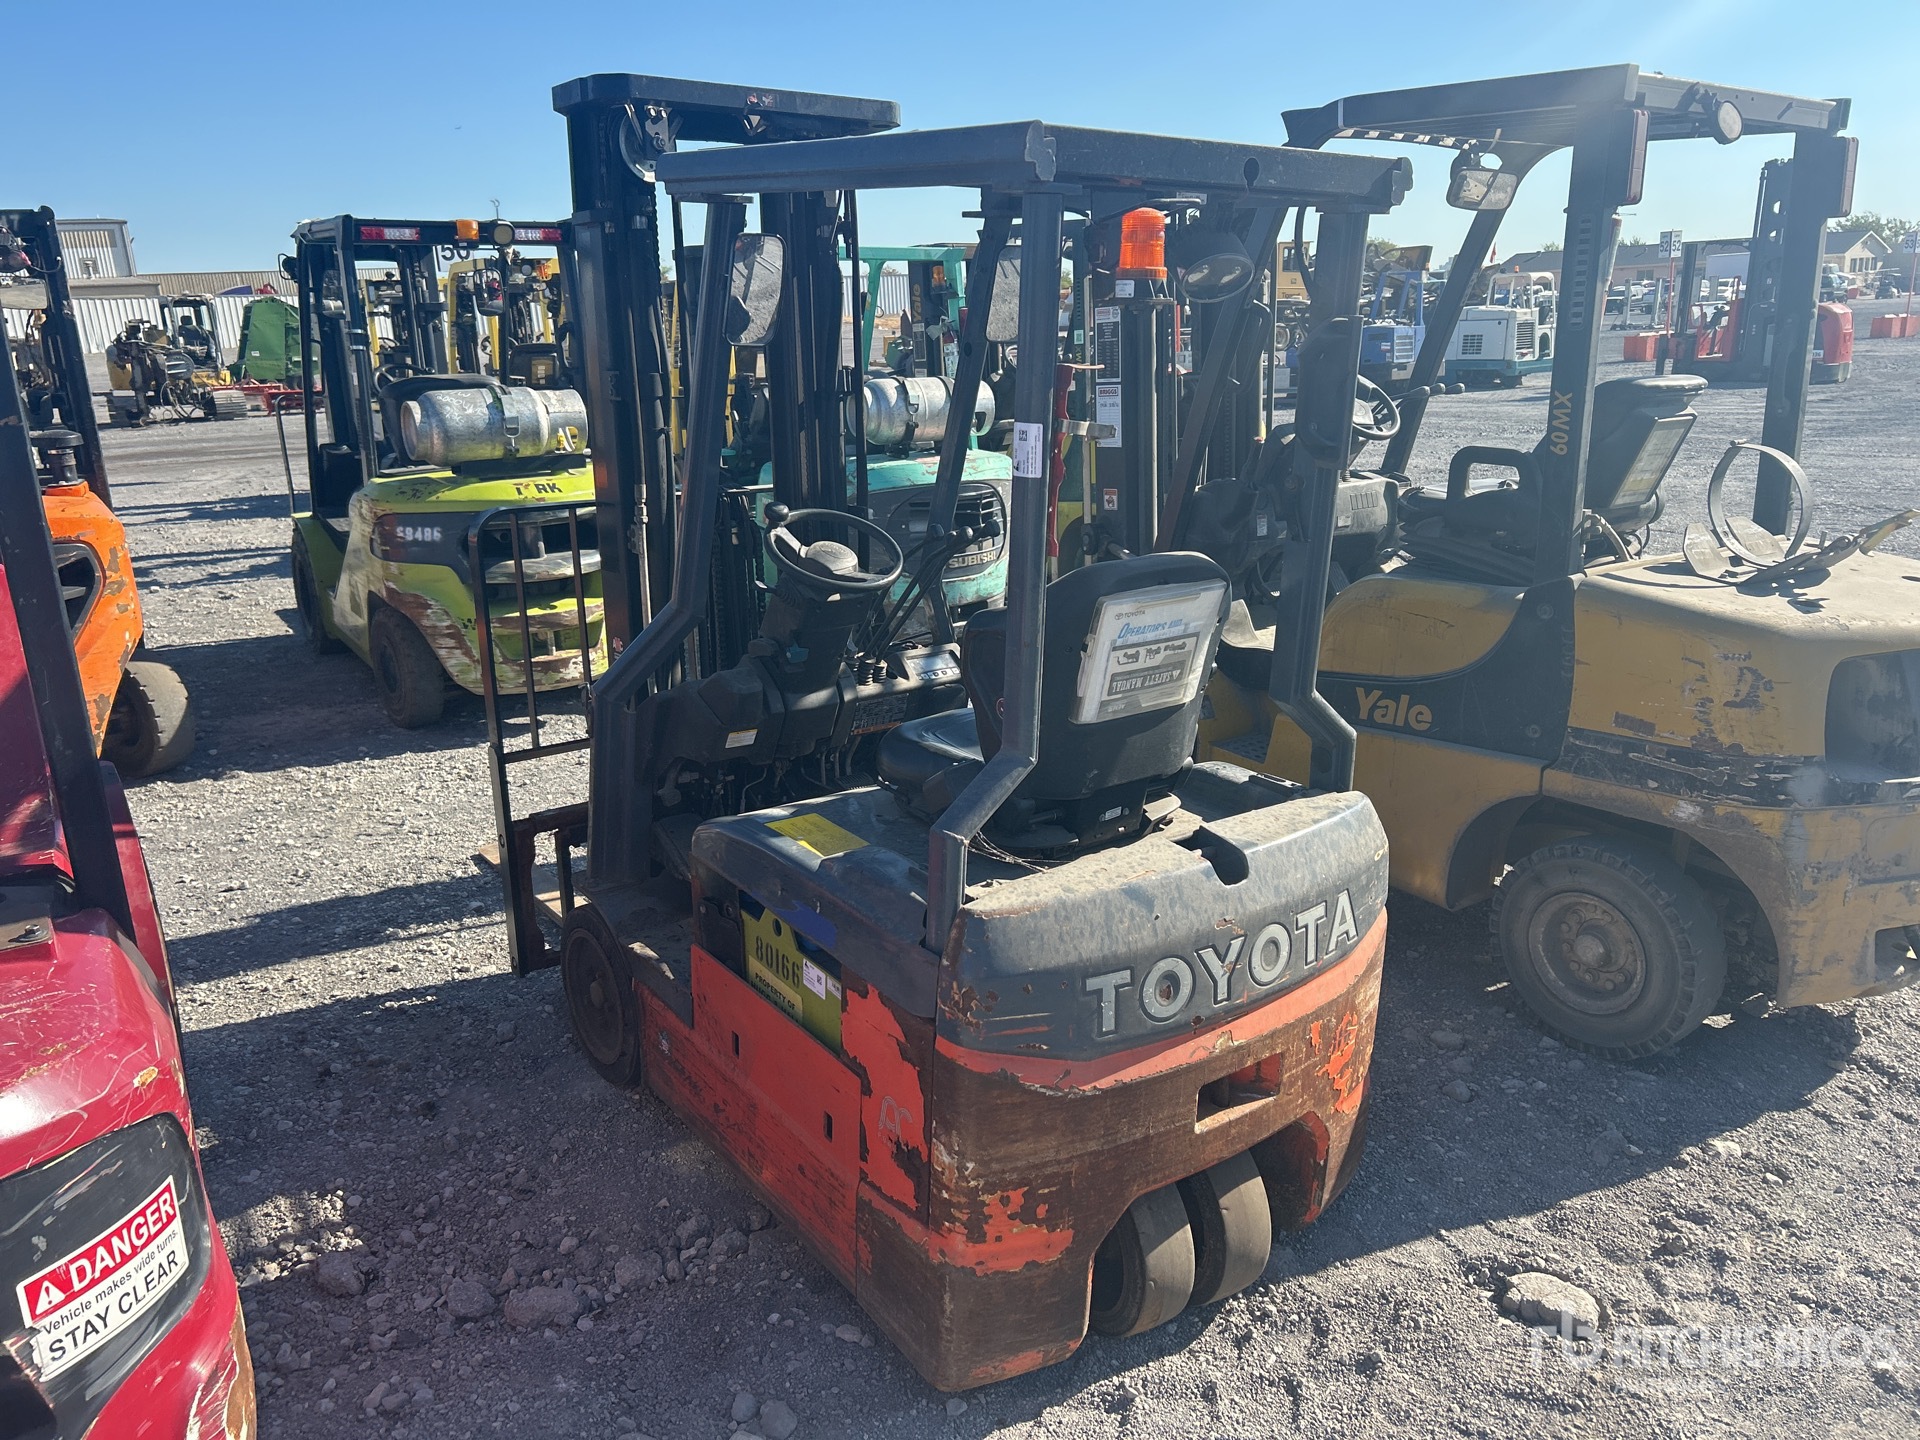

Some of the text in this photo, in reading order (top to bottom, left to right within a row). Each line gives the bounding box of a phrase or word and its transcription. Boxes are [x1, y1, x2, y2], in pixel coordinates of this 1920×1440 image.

[1660, 240, 1669, 253] 52
[1672, 239, 1681, 252] 52
[912, 283, 922, 322] Yale
[1550, 390, 1573, 456] 60MX
[1124, 609, 1146, 618] TOYOTA
[1112, 677, 1144, 693] MANUAL
[1355, 686, 1433, 731] Yale
[755, 935, 800, 989] 80166
[1084, 888, 1359, 1037] TOYOTA
[754, 972, 786, 1002] PROPERTY
[787, 1000, 796, 1011] OF
[69, 1190, 175, 1293] DANGER
[42, 1298, 92, 1335] Vehicle
[95, 1271, 132, 1303] makes
[134, 1250, 156, 1274] wide
[49, 1250, 179, 1363] STAY CLEAR
